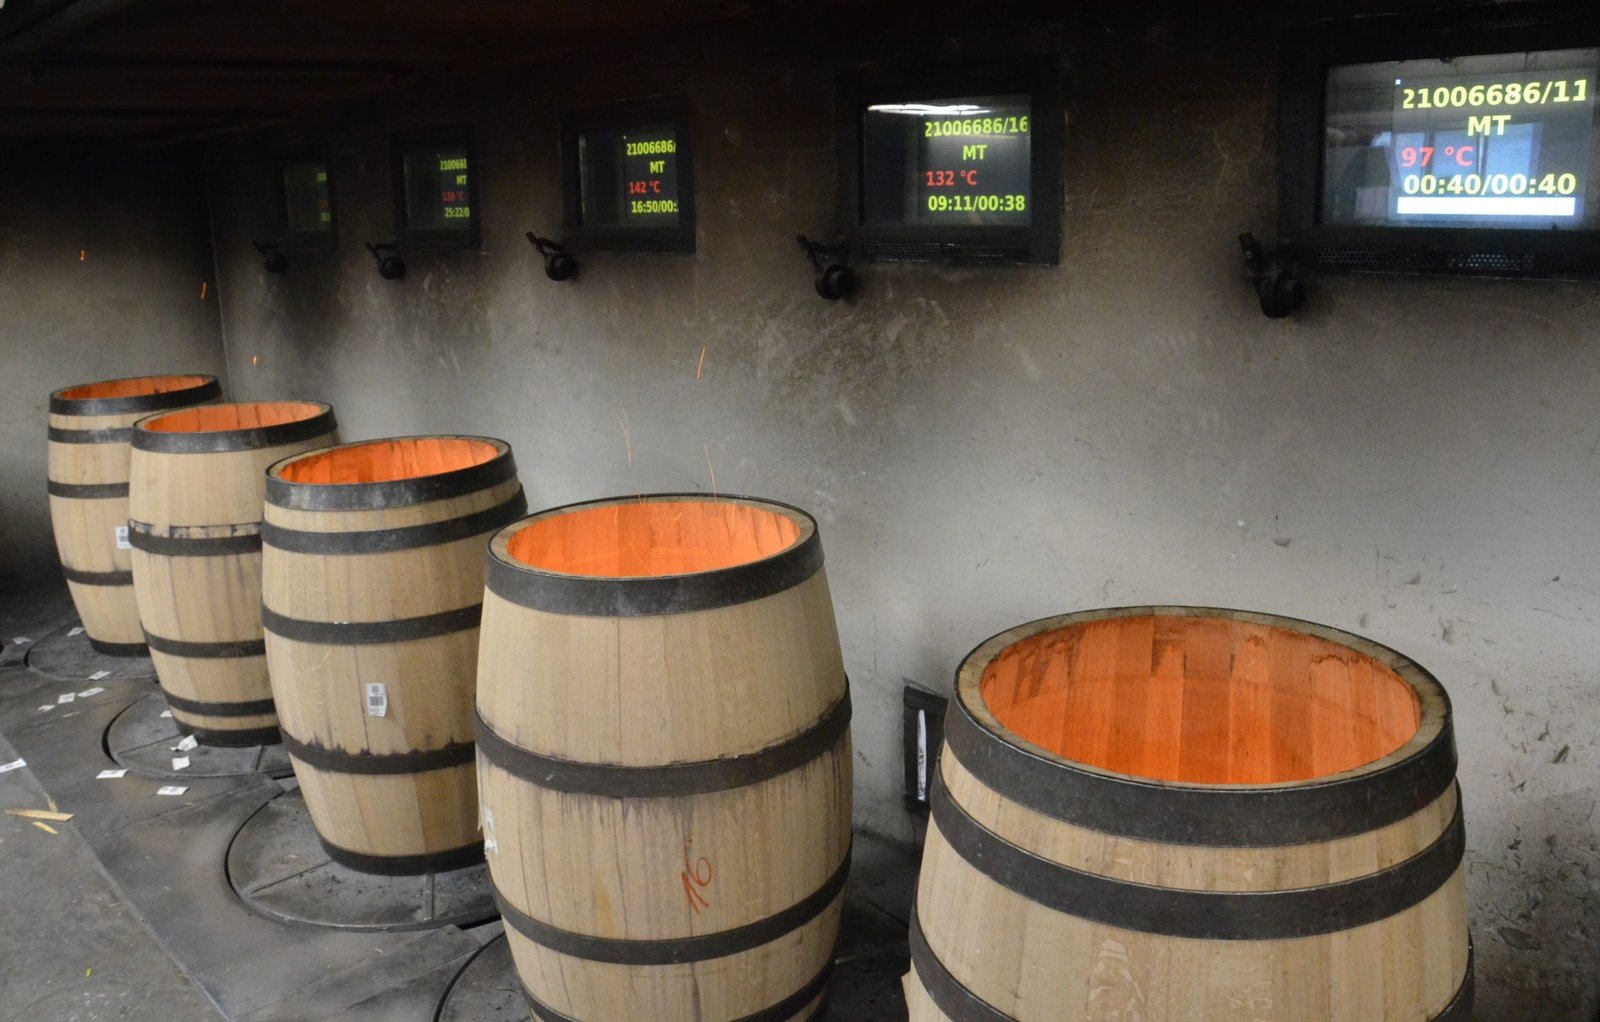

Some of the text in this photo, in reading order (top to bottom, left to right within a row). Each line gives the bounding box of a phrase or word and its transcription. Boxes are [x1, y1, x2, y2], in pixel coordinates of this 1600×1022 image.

[1402, 79, 1587, 109] 21006686/11
[925, 116, 1028, 137] 21006686/16
[1467, 114, 1511, 137] MT
[963, 144, 987, 160] MT
[1401, 146, 1473, 167] 97 °C
[649, 160, 665, 173] MT
[926, 169, 977, 186] 132 °C
[1403, 173, 1577, 196] 00:40/00:40
[628, 181, 647, 193] 142
[631, 200, 679, 213] 16:50/00:
[928, 195, 1025, 211] 09:11/00:38
